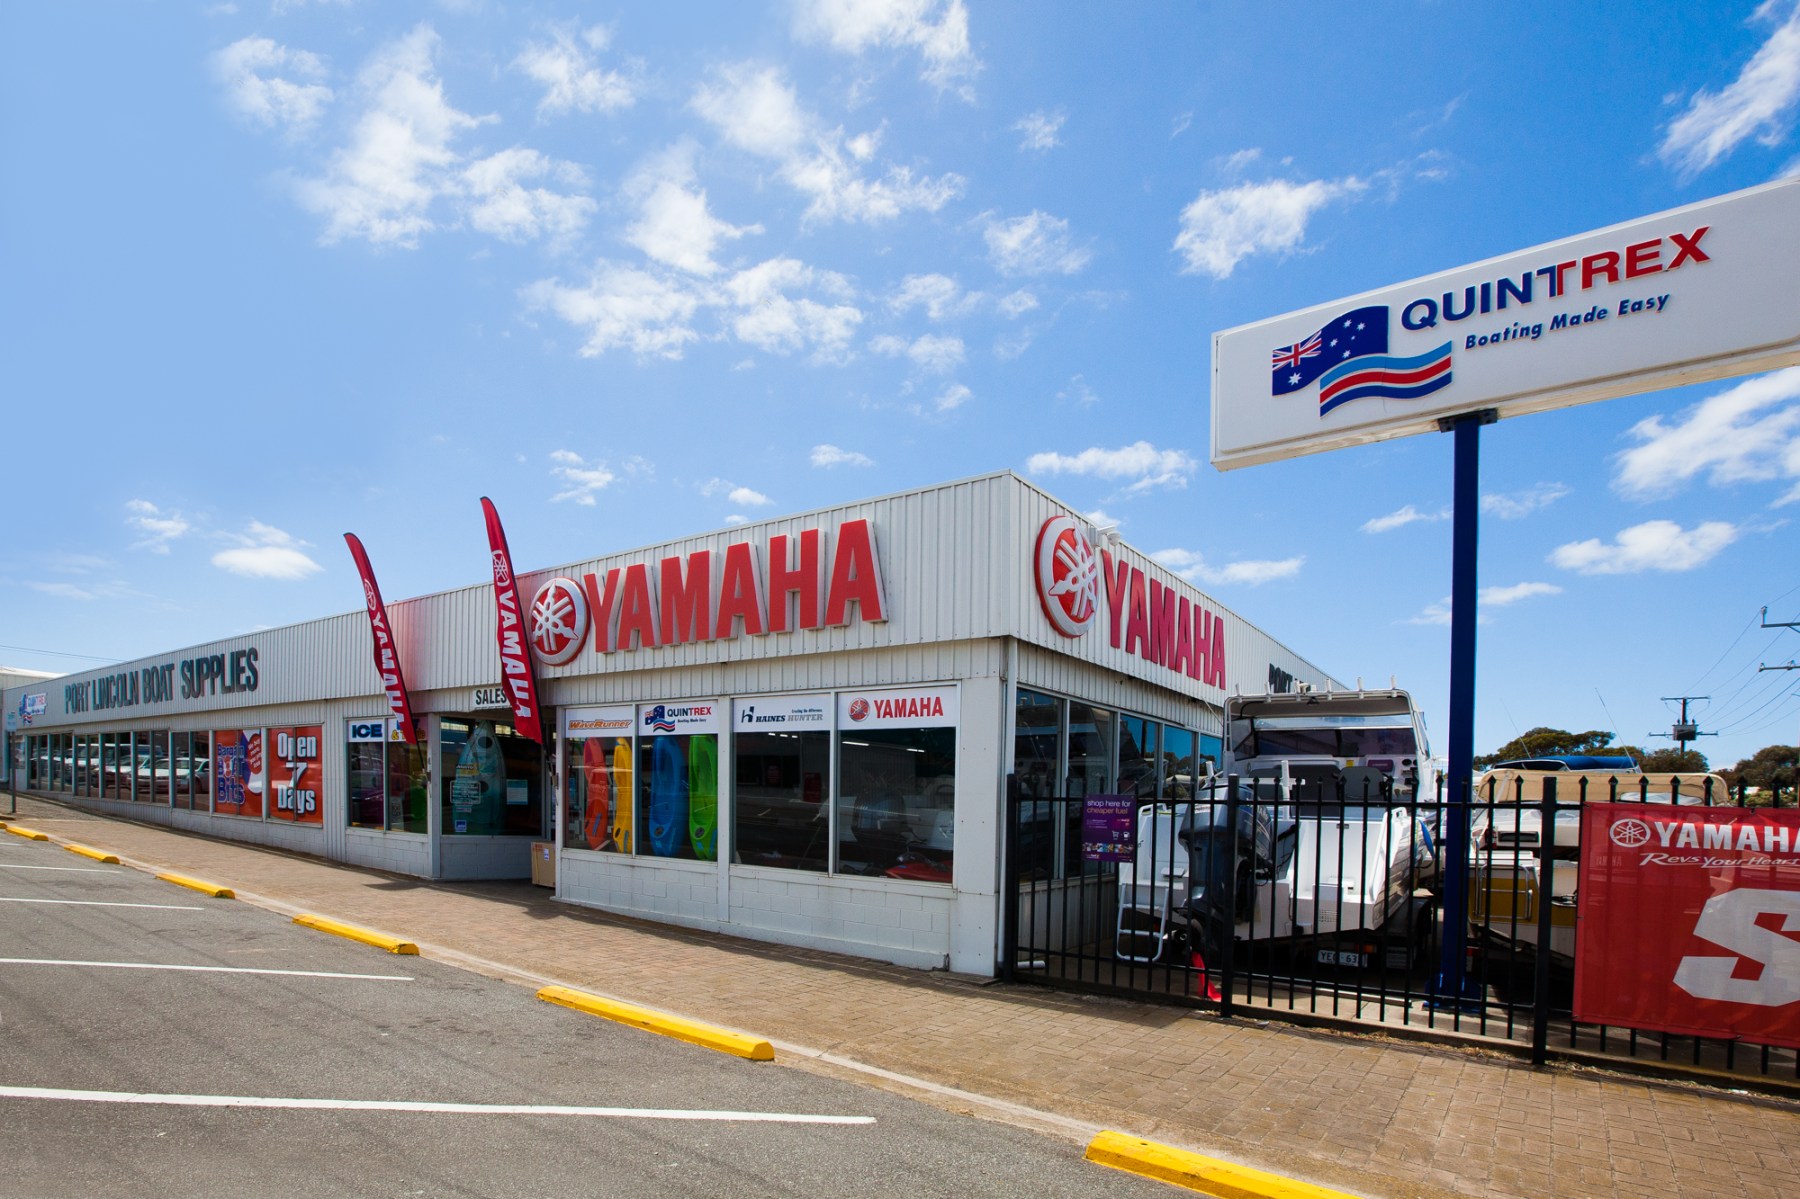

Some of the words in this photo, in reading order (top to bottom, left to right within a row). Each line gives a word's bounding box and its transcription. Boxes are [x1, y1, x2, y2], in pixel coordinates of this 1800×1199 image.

[1401, 226, 1711, 331] QUINTREX
[1465, 322, 1543, 350] Boating
[1549, 305, 1608, 331] Made
[1618, 294, 1670, 316] Easy
[583, 518, 888, 654] YAMAHA
[1100, 548, 1226, 691] YAMAHA
[64, 680, 90, 714] PORT
[92, 670, 139, 711] LINCOLN
[142, 663, 175, 704] BOAT
[181, 647, 258, 699] SUPPLIES
[475, 688, 507, 705] SALES
[873, 696, 944, 719] YAMAHA
[569, 719, 632, 730] WaveRunner
[667, 706, 712, 717] QUINTREX
[756, 714, 786, 722] HAINES
[787, 713, 824, 722] HUNTER
[351, 724, 382, 738] ICE
[277, 732, 317, 760] Open
[285, 762, 307, 787] 7
[218, 776, 246, 805] Bits
[277, 784, 315, 814] Days
[1087, 800, 1104, 808] shop
[1639, 852, 1700, 866] Revs
[1701, 856, 1742, 868] Your
[1673, 887, 1800, 1007] S
